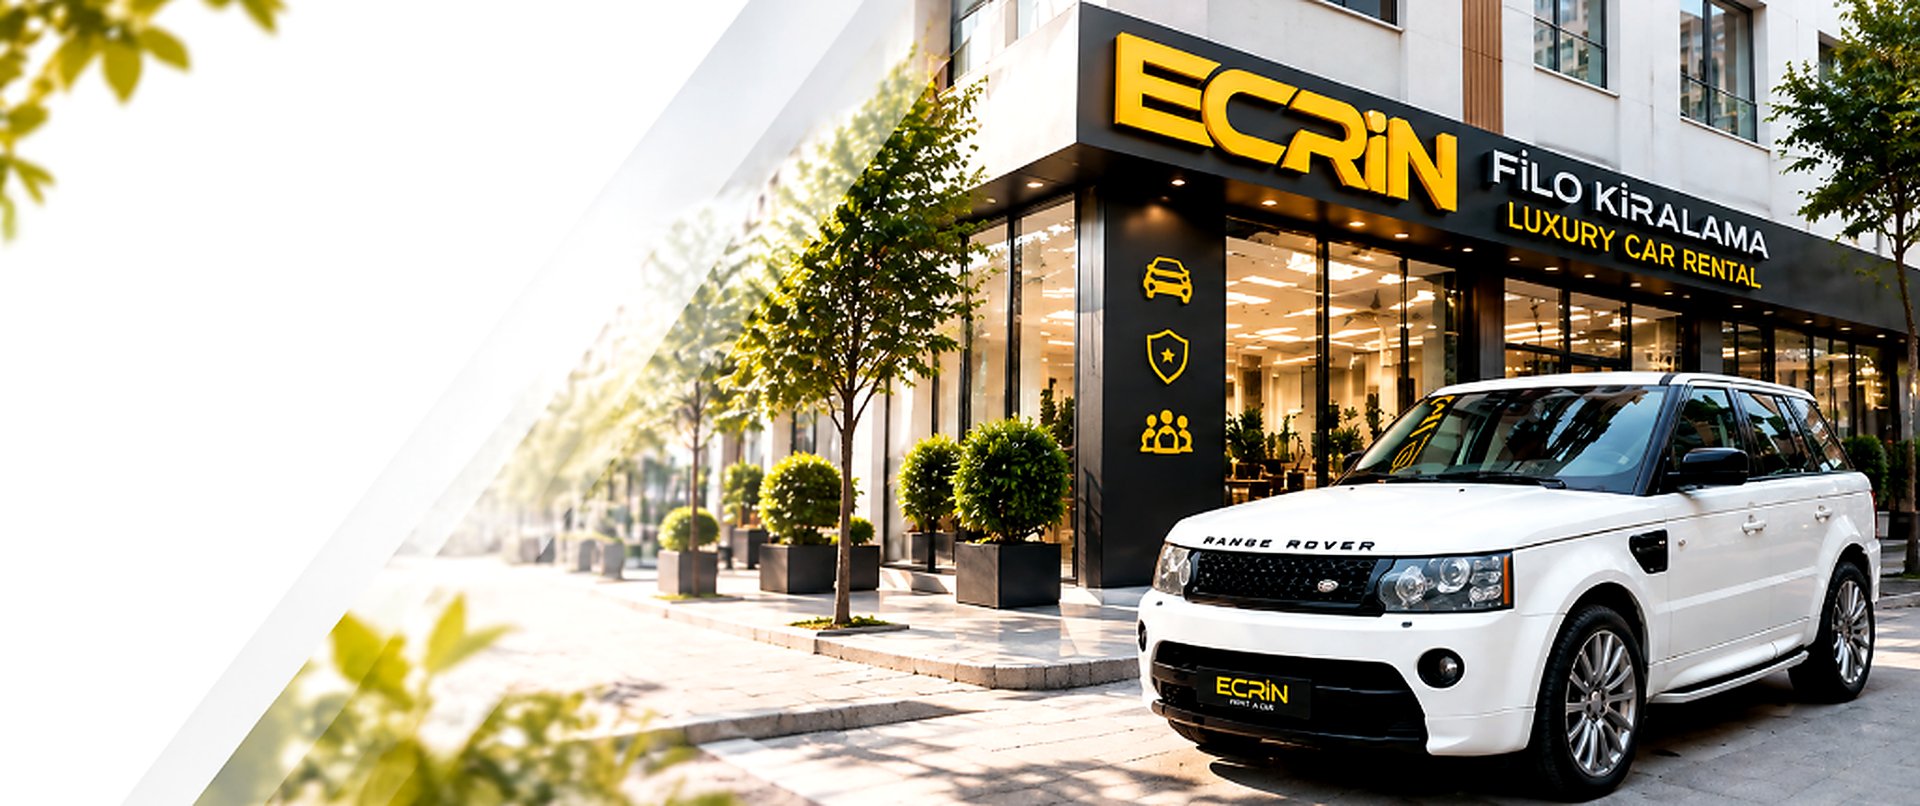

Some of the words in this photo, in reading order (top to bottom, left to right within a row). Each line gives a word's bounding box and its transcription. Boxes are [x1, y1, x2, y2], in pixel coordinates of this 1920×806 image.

[1508, 201, 1616, 252] LUXURY
[1624, 234, 1675, 268] CAR
[1683, 248, 1762, 290] RENTAL
[1203, 536, 1273, 549] RANGE
[1286, 539, 1375, 551] ROVER
